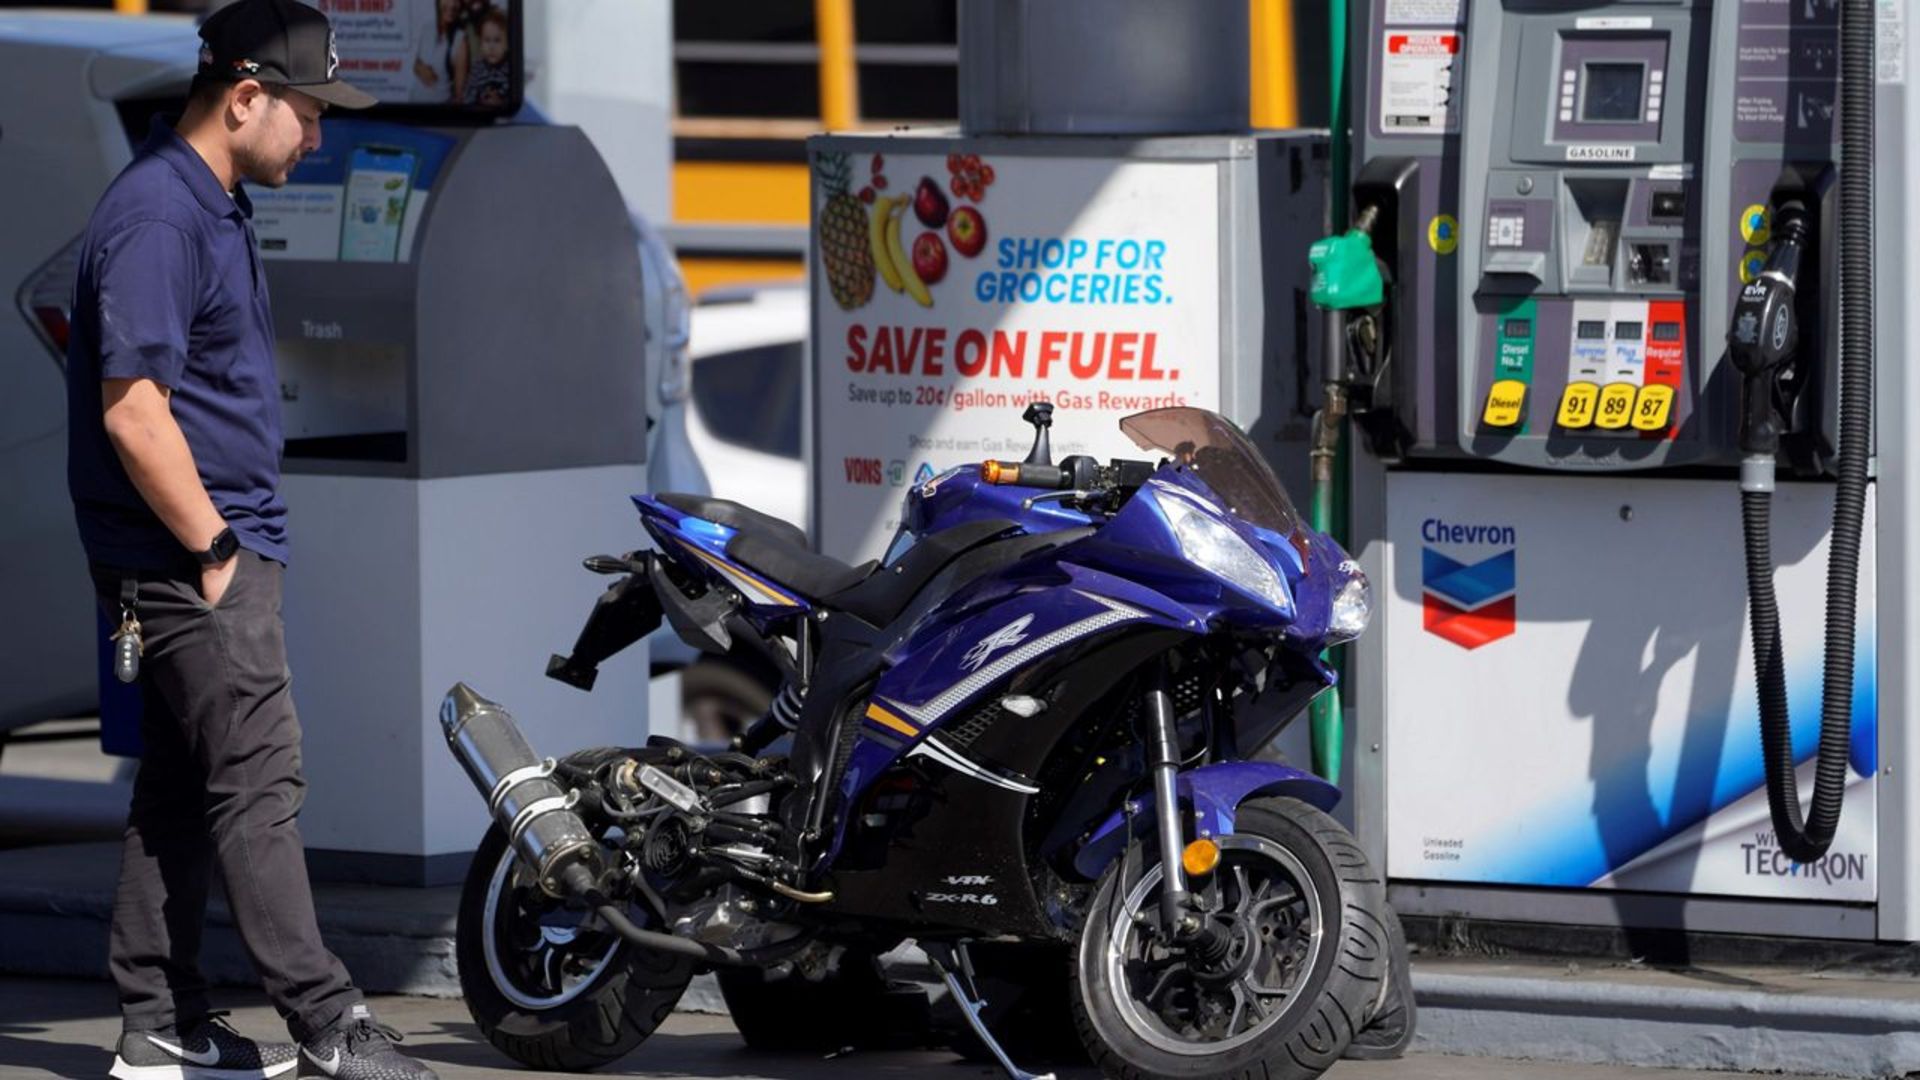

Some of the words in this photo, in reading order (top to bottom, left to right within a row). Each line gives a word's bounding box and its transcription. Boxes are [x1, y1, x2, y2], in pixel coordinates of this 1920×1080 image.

[1570, 148, 1633, 159] GASOLINE
[997, 237, 1088, 270] SHOP
[1095, 239, 1166, 270] FOR
[976, 271, 1173, 305] GROCERIES.
[302, 320, 342, 339] Trash
[846, 324, 946, 377] SAVE
[954, 328, 1027, 379] ON
[1037, 331, 1180, 381] FUEL.
[1501, 344, 1529, 354] Diesel
[1646, 347, 1682, 360] Regular
[1501, 356, 1523, 367] No.2
[848, 384, 877, 403] Save
[880, 388, 896, 407] up
[898, 388, 912, 405] to
[1011, 390, 1050, 407] with
[1056, 391, 1092, 409] Gas
[1099, 392, 1187, 411] Rewards
[1490, 399, 1520, 408] Diesel
[1567, 396, 1588, 415] 91
[1604, 397, 1627, 415] 89
[1641, 398, 1664, 417] 87
[909, 434, 932, 450] Shop
[981, 438, 1003, 452] Gas
[844, 457, 882, 485] VONS
[1421, 518, 1516, 545] Chevron
[1423, 837, 1463, 849] Unleaded
[1423, 850, 1461, 860] Gasoline
